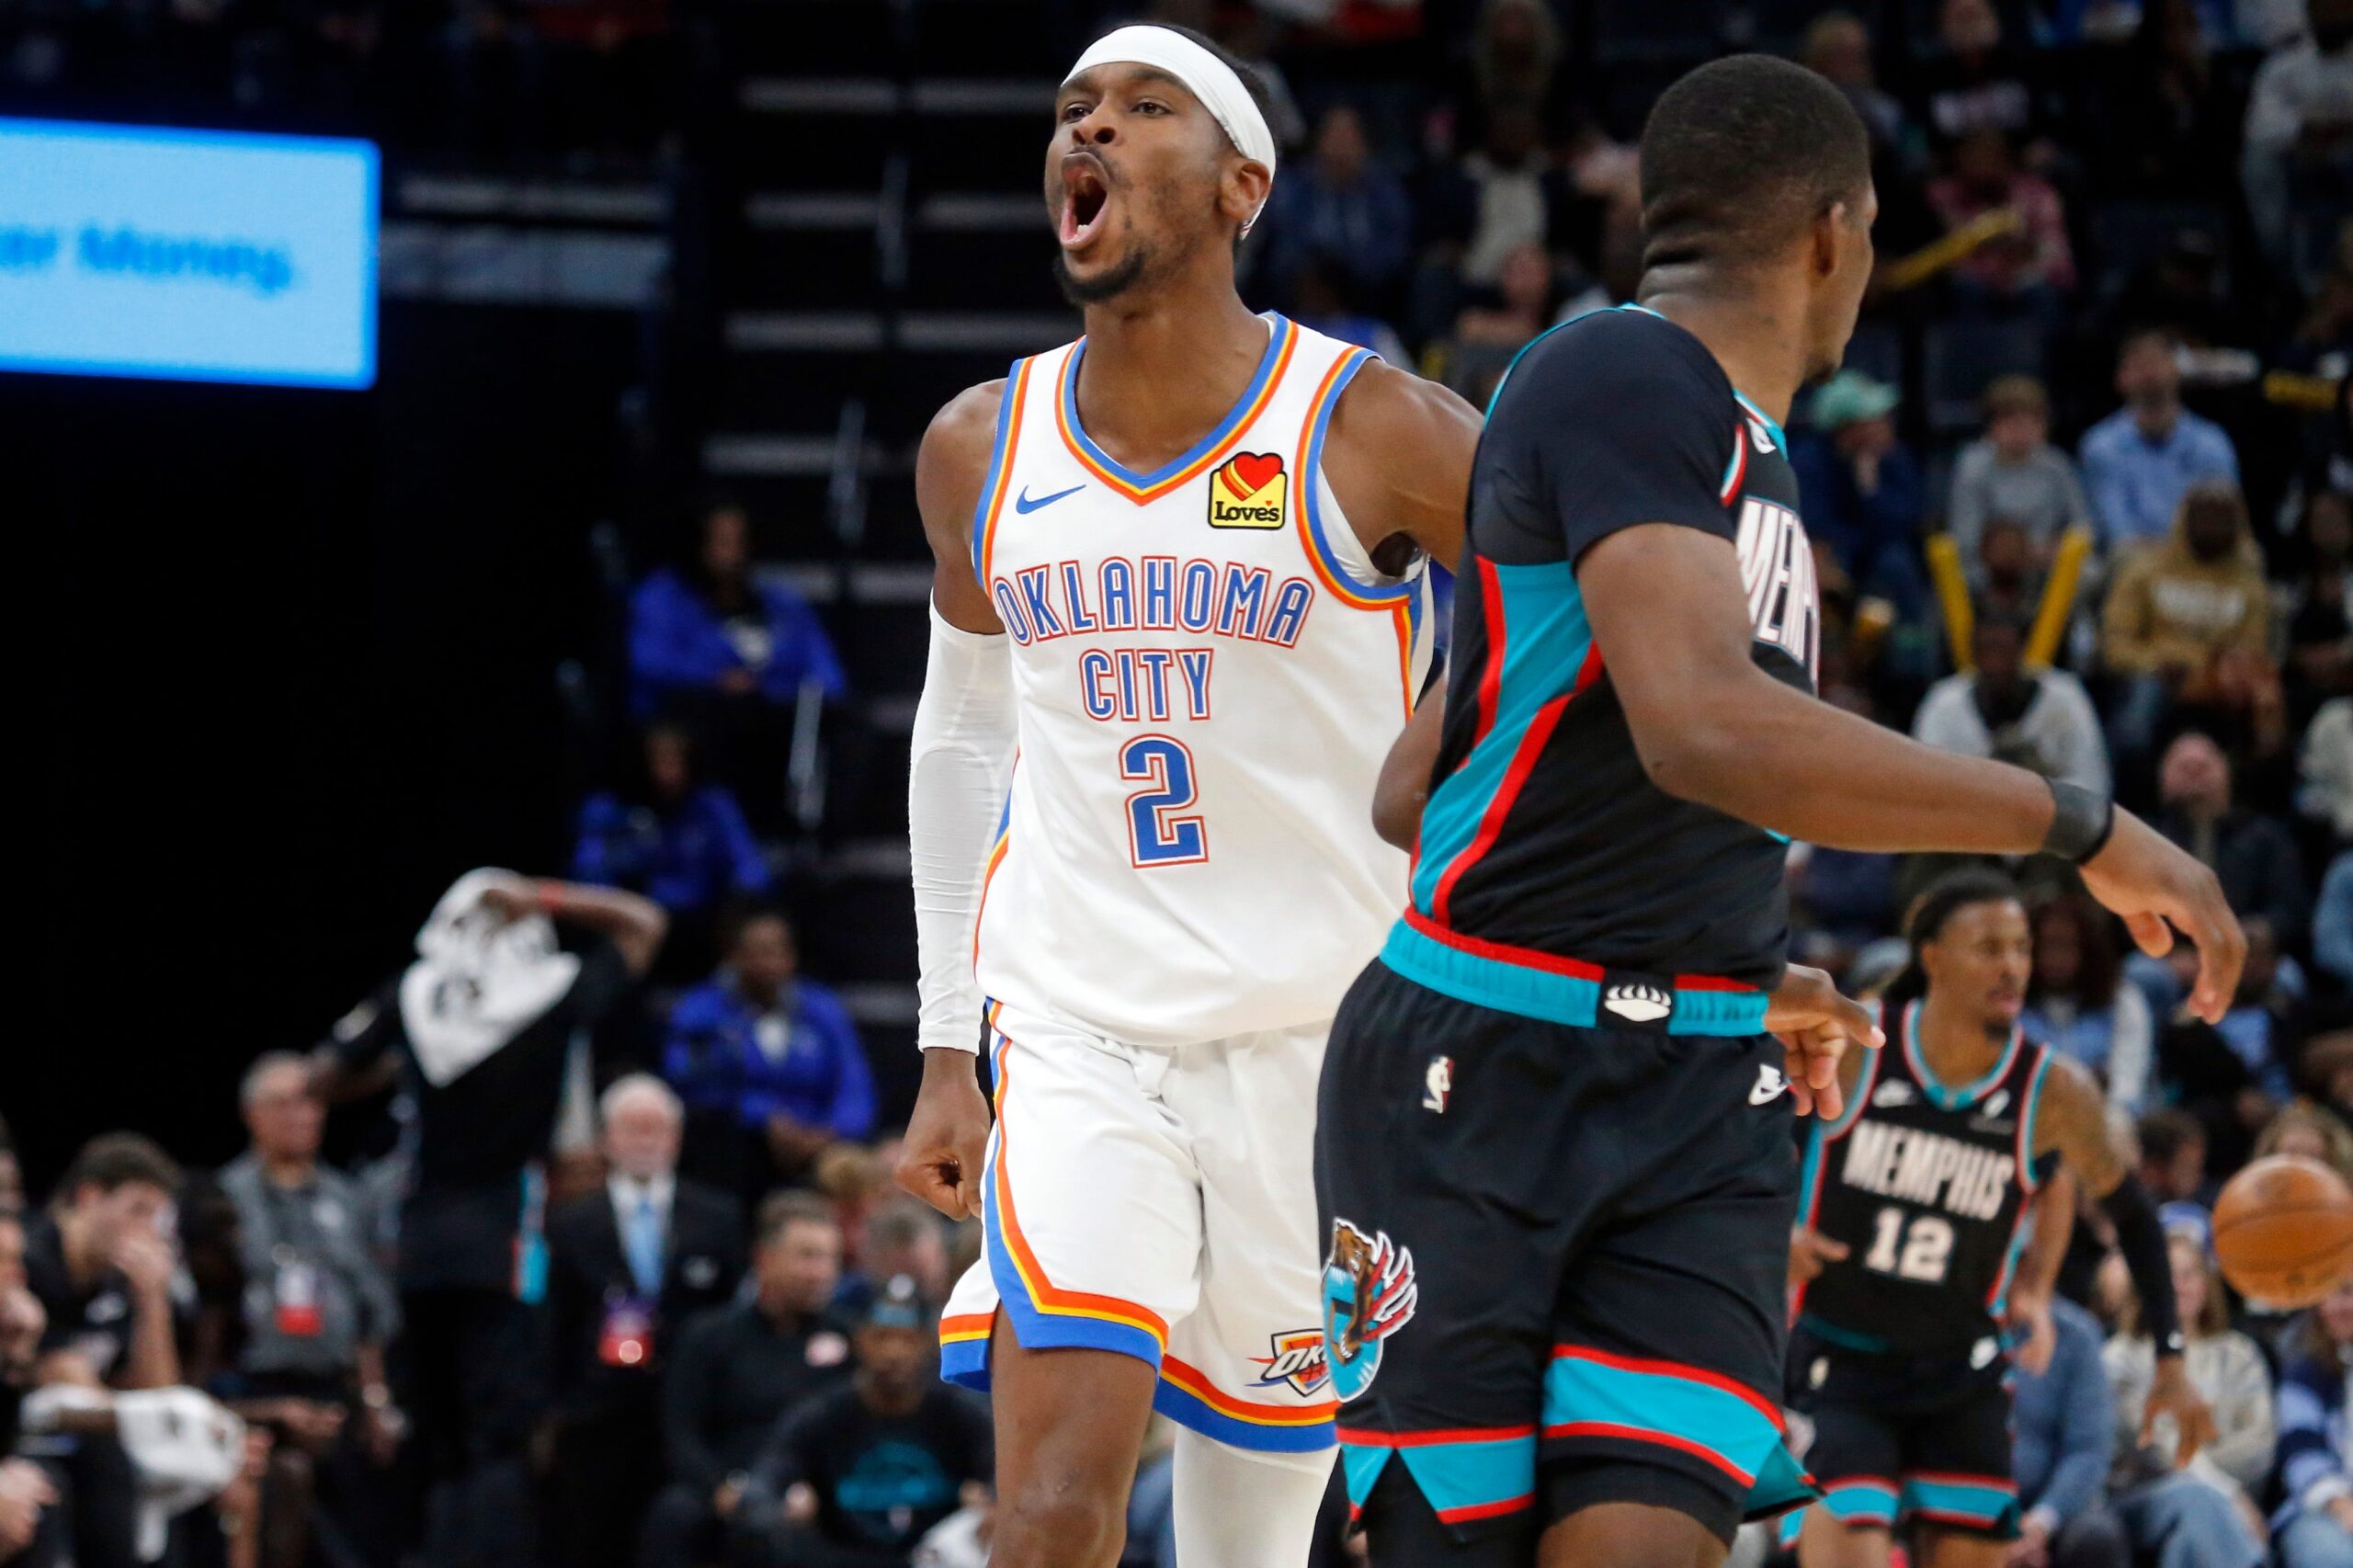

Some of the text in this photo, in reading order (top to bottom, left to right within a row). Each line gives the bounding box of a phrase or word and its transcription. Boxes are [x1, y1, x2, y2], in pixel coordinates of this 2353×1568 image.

[993, 556, 1315, 649] OKLAHOMA
[1079, 648, 1213, 722] CITY
[1119, 733, 1210, 869] 2
[1842, 1119, 2016, 1221] MEMPHIS
[1865, 1206, 1955, 1284] 12
[1262, 1344, 1327, 1381] OK
